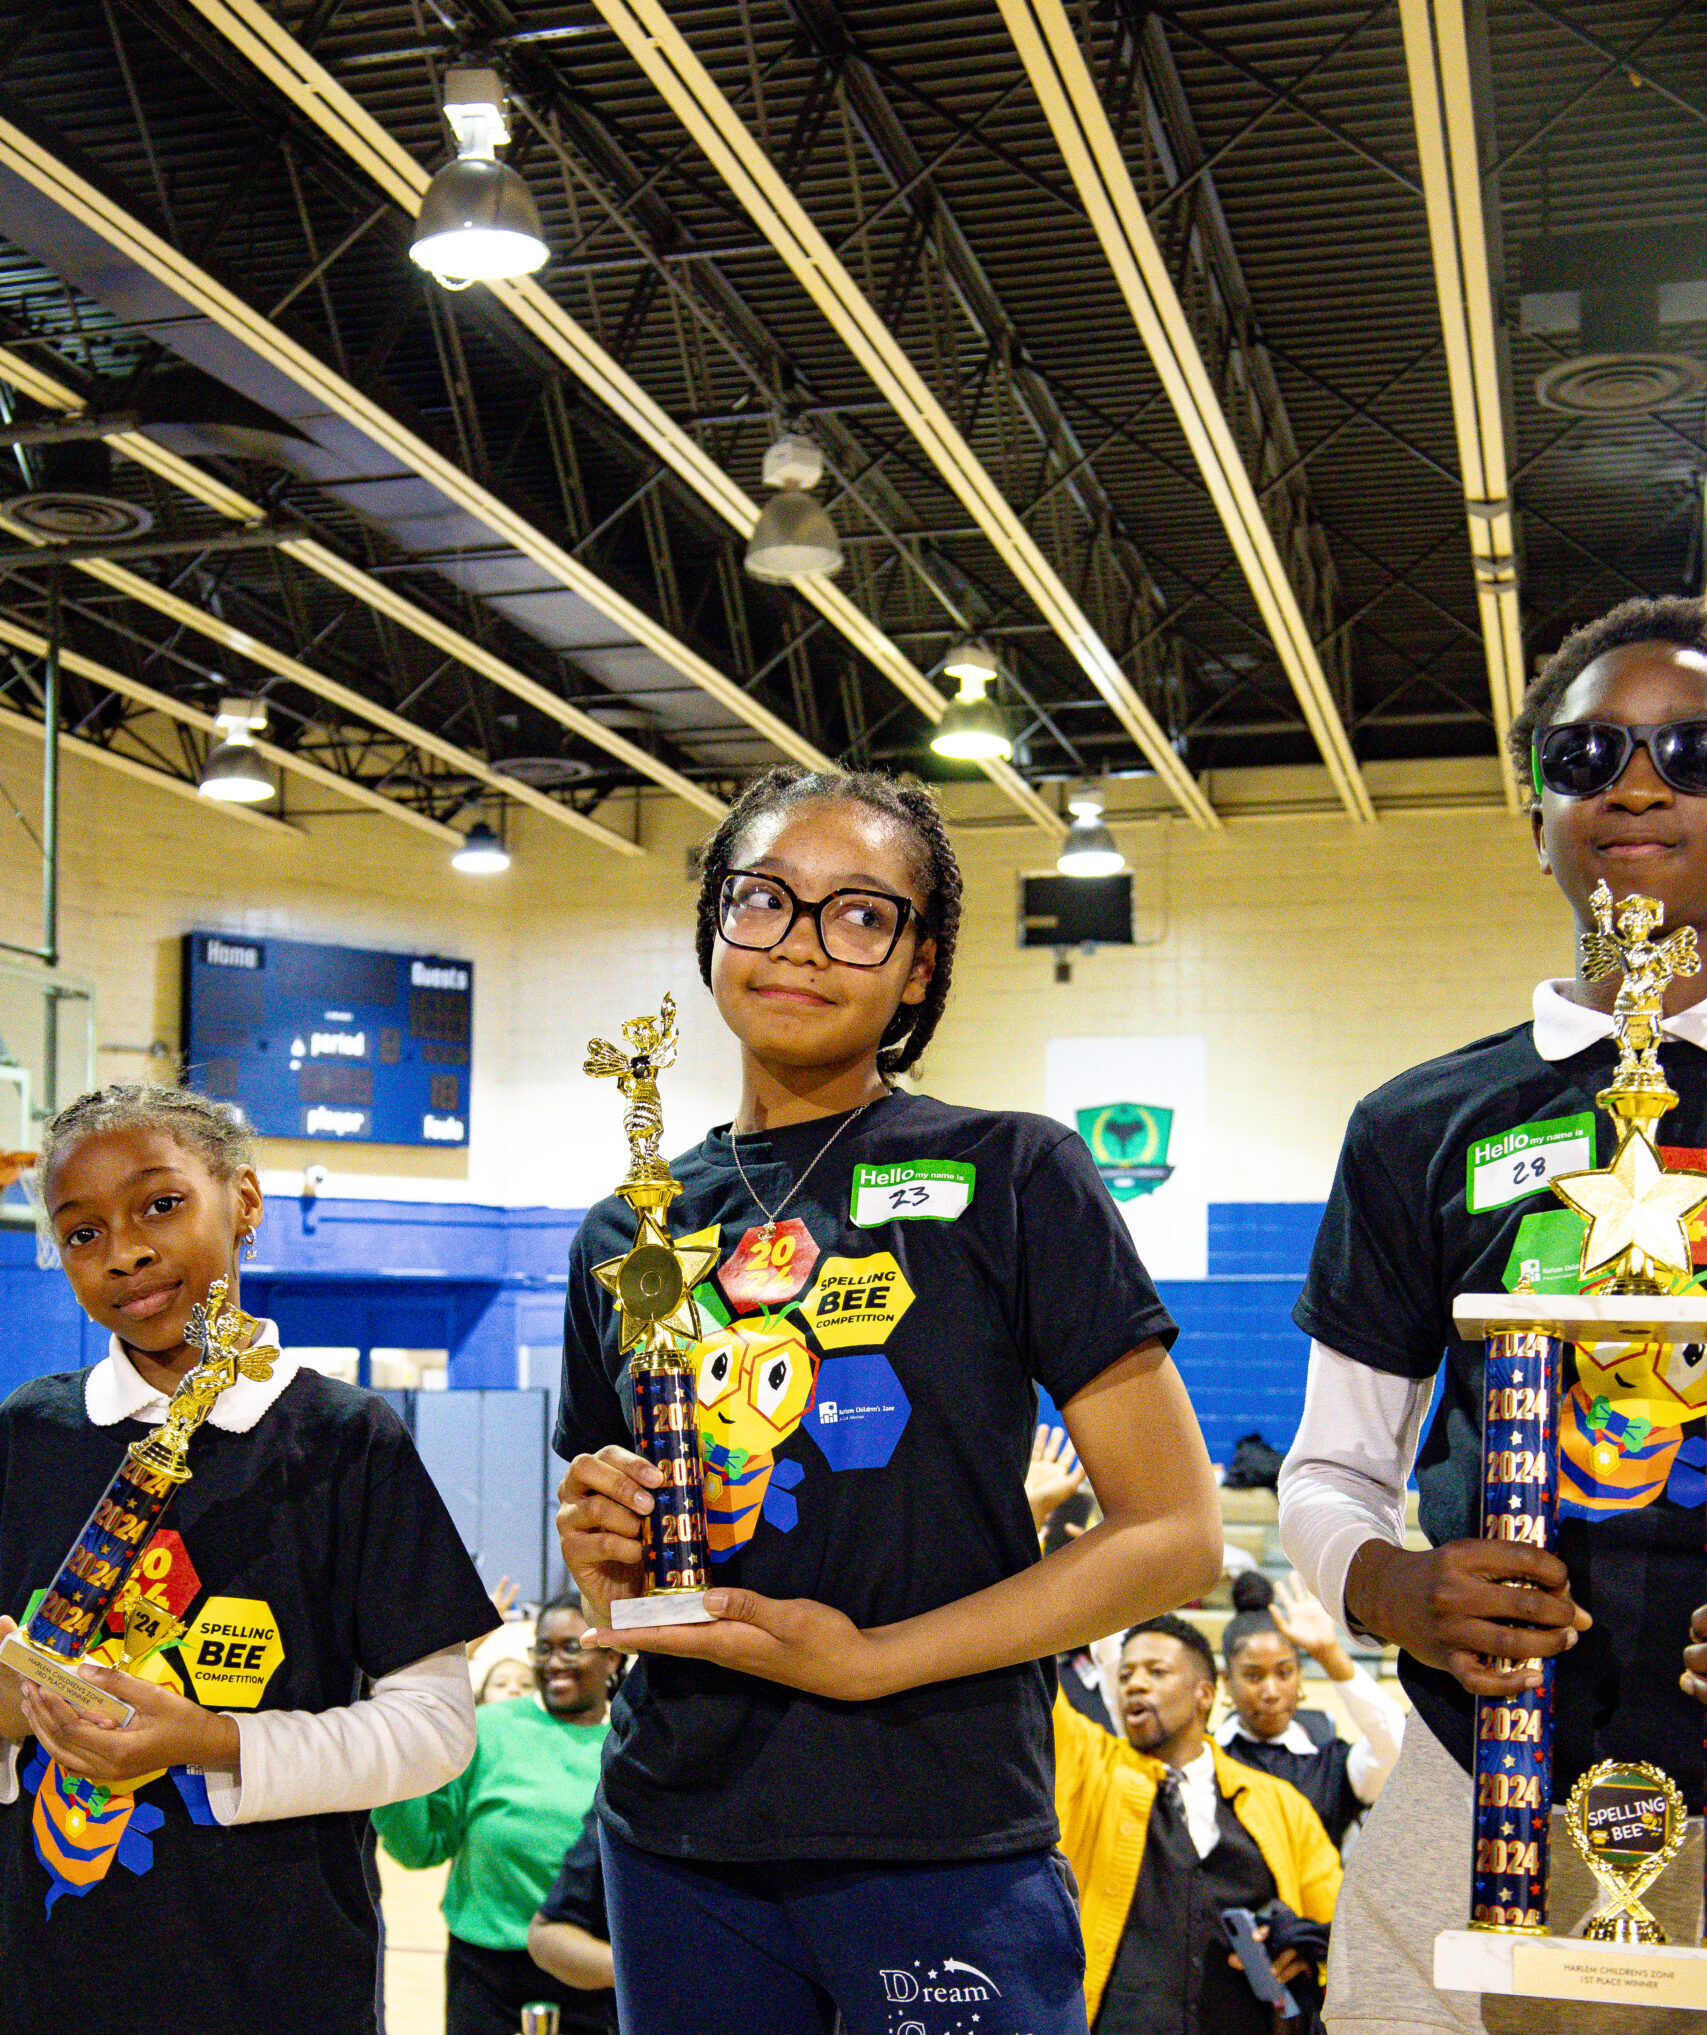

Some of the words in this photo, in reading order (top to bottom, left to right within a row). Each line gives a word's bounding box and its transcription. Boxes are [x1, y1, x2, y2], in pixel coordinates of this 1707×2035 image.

[1474, 1132, 1529, 1165] Hello
[1530, 1135, 1544, 1145] my
[1546, 1131, 1573, 1142] name
[1575, 1128, 1584, 1137] is
[859, 1168, 914, 1186] Hello
[915, 1170, 927, 1180] my
[928, 1171, 955, 1181] name
[955, 1173, 964, 1182] is
[1513, 1156, 1547, 1185] 28
[888, 1185, 930, 1210] 23
[745, 1235, 796, 1271] 20
[820, 1270, 896, 1292] SPELLING
[816, 1286, 890, 1317] BEE
[816, 1313, 895, 1330] COMPETITION
[1488, 1332, 1550, 1360] 2024
[1487, 1387, 1549, 1422] 2024
[1486, 1450, 1548, 1485] 2024
[92, 1498, 149, 1546] 2024
[661, 1512, 707, 1544] 202
[1485, 1513, 1548, 1549] 2024
[66, 1545, 123, 1591] 2024
[38, 1591, 96, 1637] 2024
[200, 1622, 274, 1641] SPELLING
[196, 1640, 267, 1670] BEE
[27, 1657, 51, 1675] HARLEM
[86, 1690, 105, 1705] ZONE
[34, 1669, 47, 1679] 3RD
[48, 1676, 66, 1691] PLACE
[66, 1688, 92, 1705] WINNER
[195, 1671, 264, 1685] COMPETITION
[1479, 1706, 1543, 1744] 2024
[1478, 1772, 1541, 1810] 2024
[1588, 1796, 1666, 1826] SPELLING
[1611, 1822, 1645, 1841] BEE
[1476, 1838, 1540, 1876] 2024
[879, 1969, 990, 2003] Dream
[1563, 1963, 1597, 1973] HARLEM
[1650, 1970, 1675, 1980] ZONE
[1596, 1977, 1622, 1987] PLACE
[1624, 1979, 1659, 1989] WINNER
